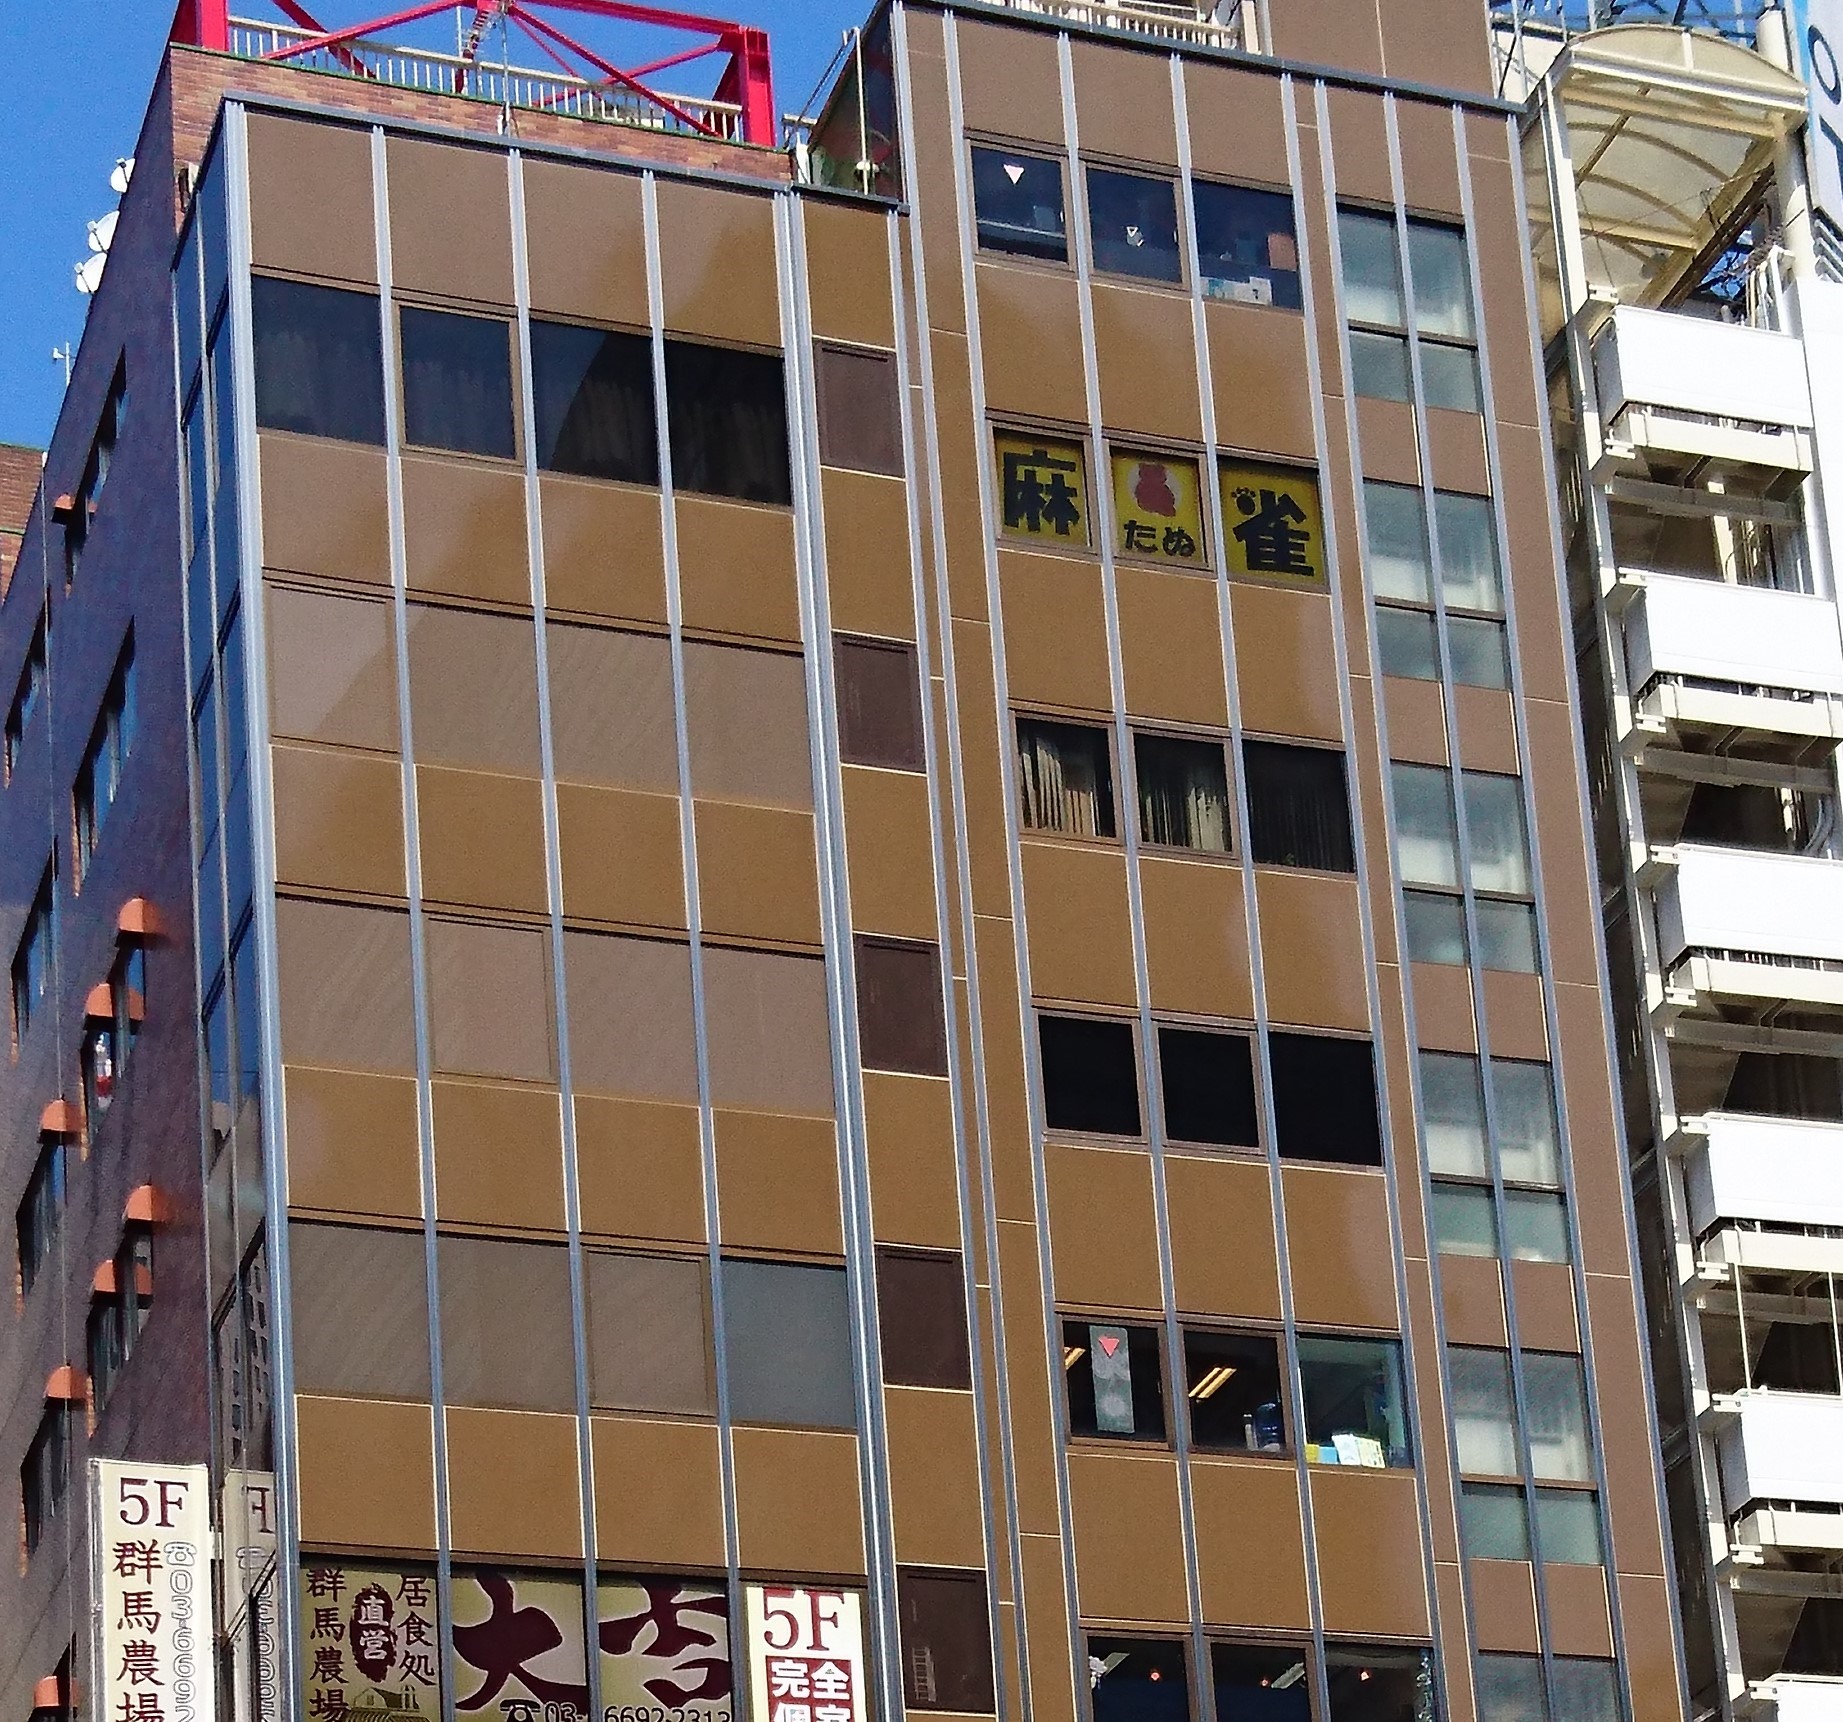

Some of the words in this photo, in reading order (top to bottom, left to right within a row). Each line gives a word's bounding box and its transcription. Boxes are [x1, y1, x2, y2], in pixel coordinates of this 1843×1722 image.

[1003, 450, 1081, 536] 麻
[1123, 519, 1196, 558] たぬ
[119, 1477, 189, 1528] 5F
[358, 1594, 389, 1660] 直営
[395, 1574, 437, 1686] 居食処
[763, 1587, 845, 1651] 5F
[770, 1659, 851, 1700] 完全
